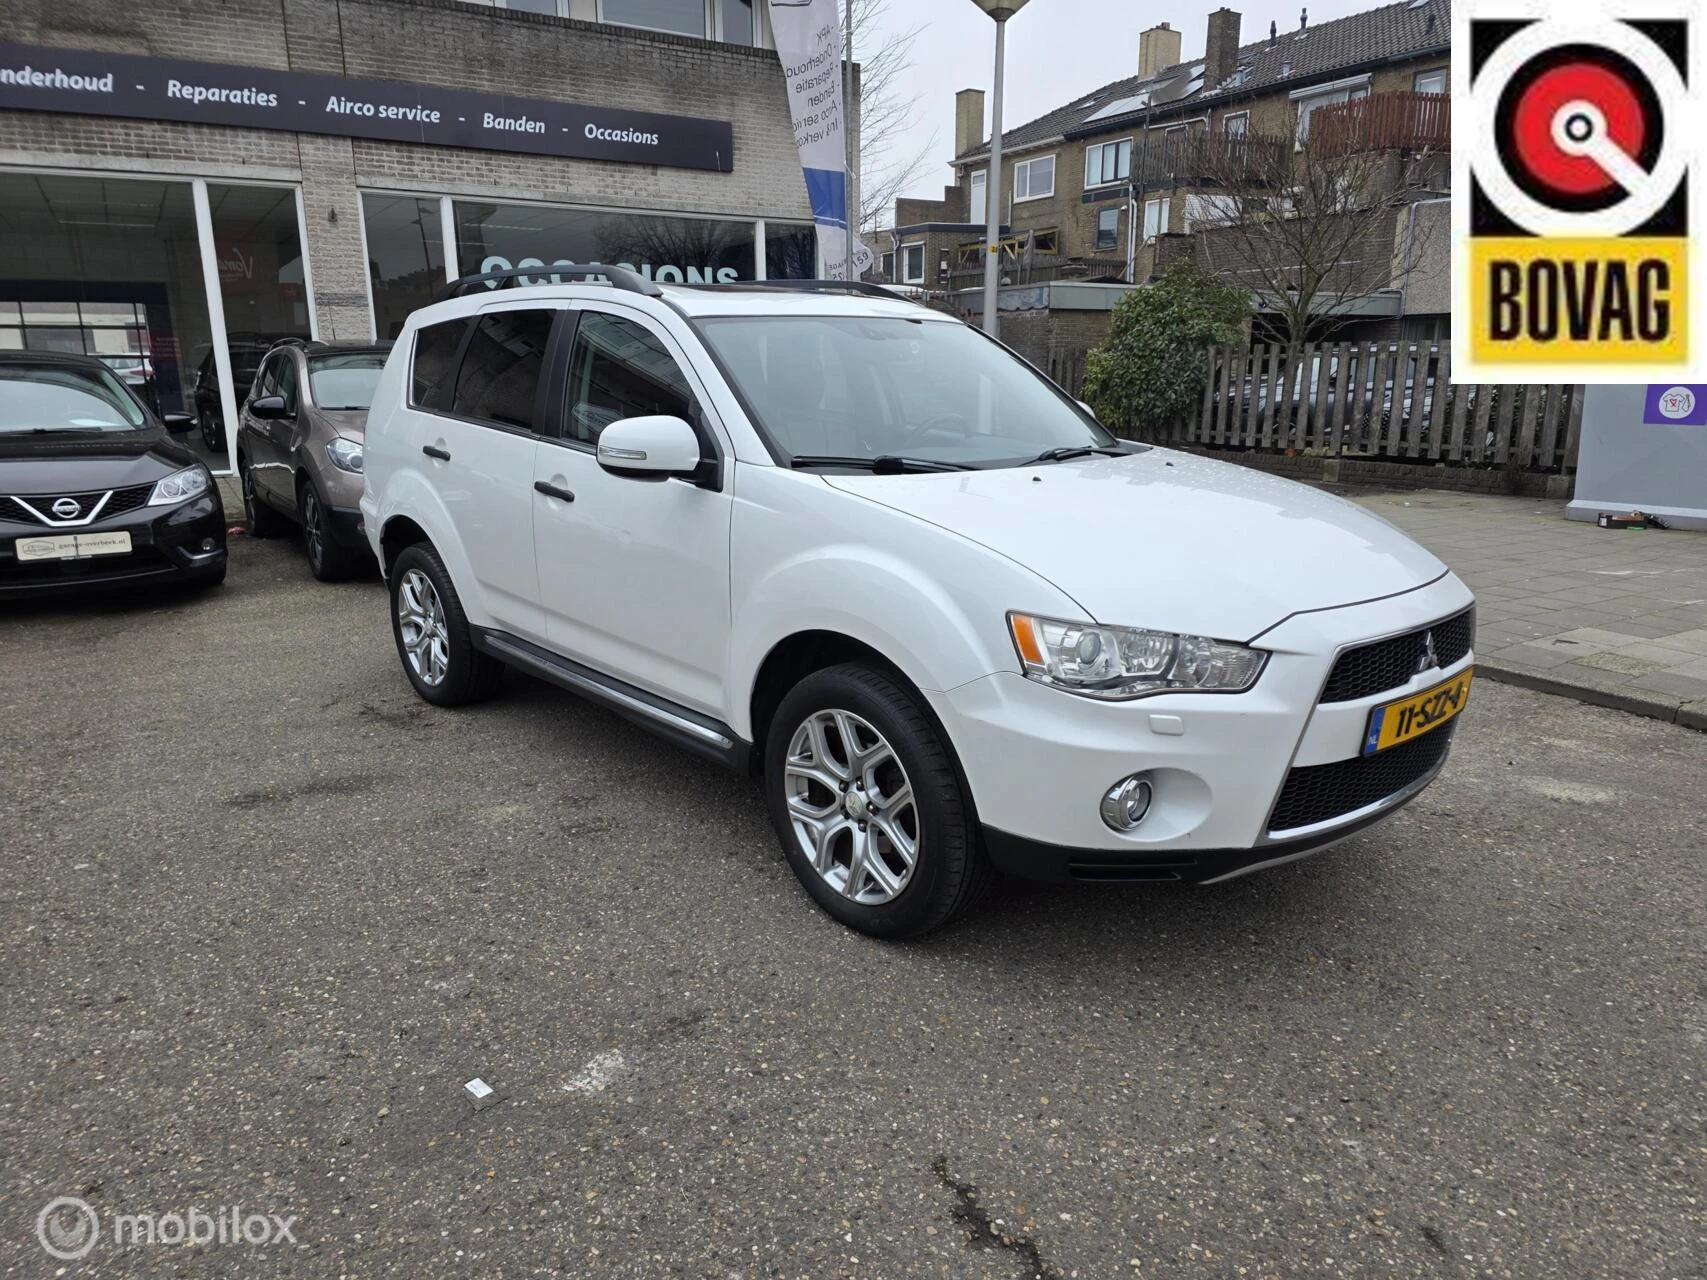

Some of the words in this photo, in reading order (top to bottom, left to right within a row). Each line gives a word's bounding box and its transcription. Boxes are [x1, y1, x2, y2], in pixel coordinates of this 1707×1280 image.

[0, 65, 114, 93] nderhoud
[167, 79, 279, 107] Reparaties
[325, 95, 375, 117] Airco
[378, 105, 441, 123] service
[483, 112, 546, 134] Banden
[584, 123, 660, 146] Occasions
